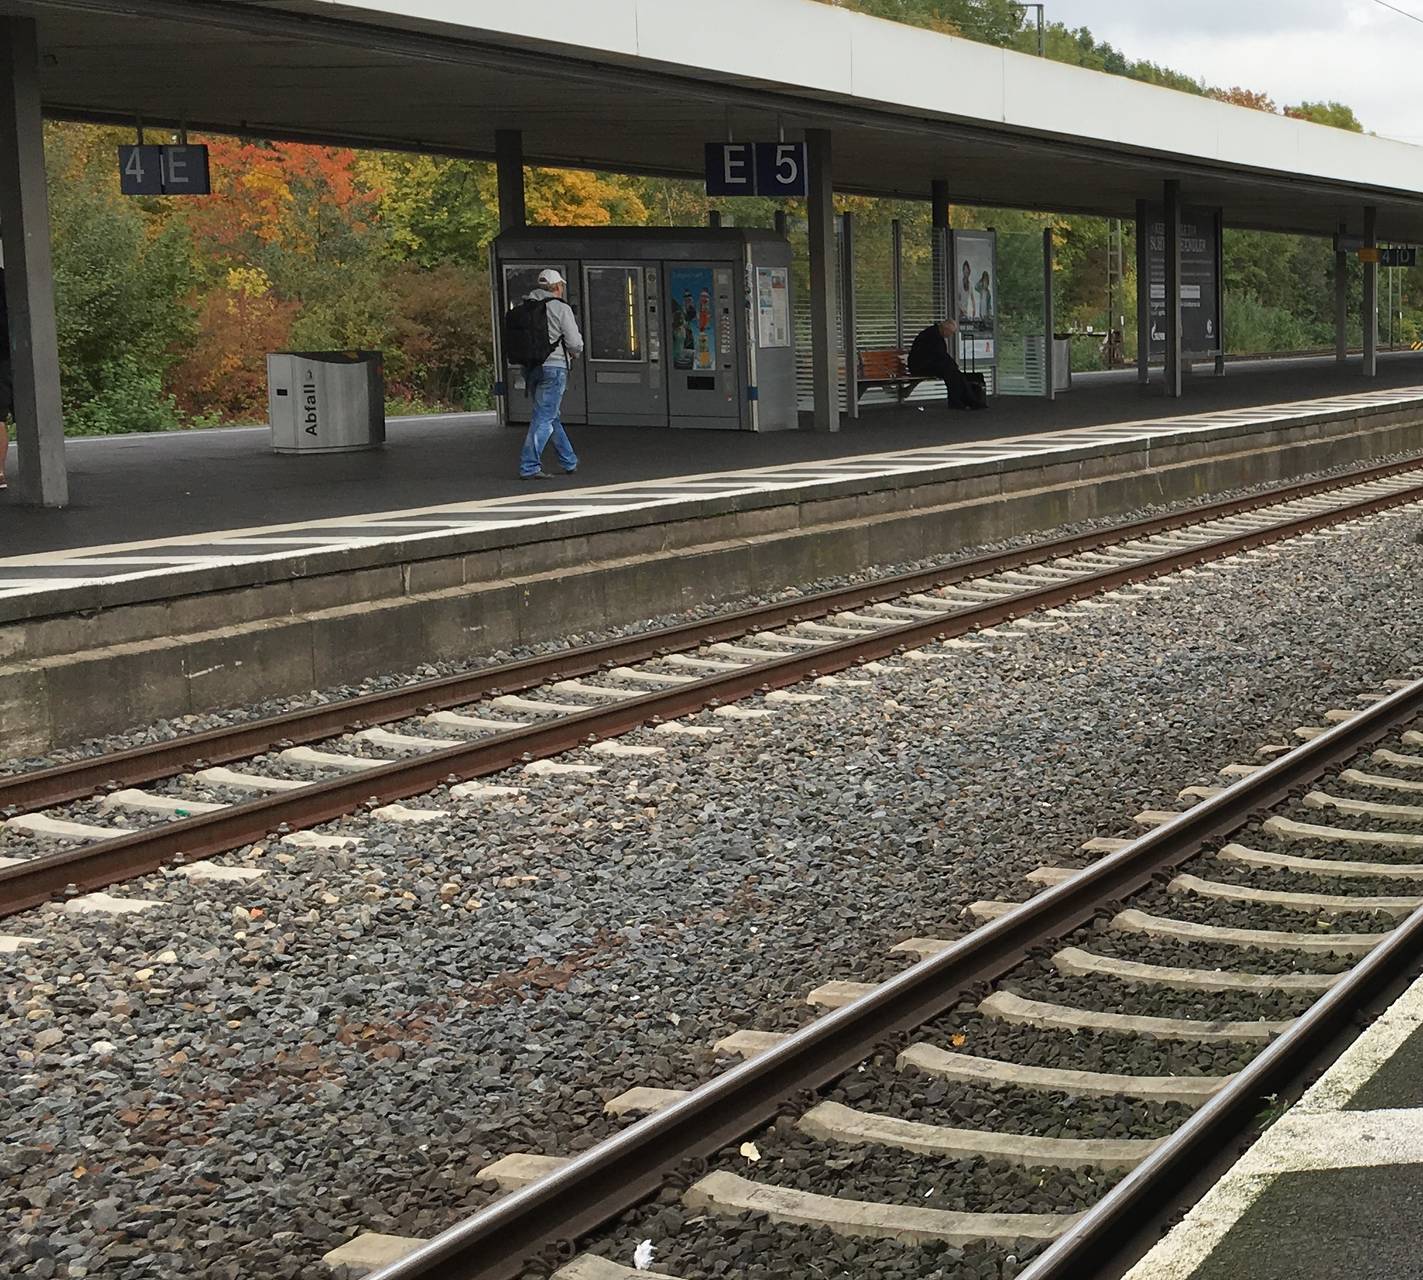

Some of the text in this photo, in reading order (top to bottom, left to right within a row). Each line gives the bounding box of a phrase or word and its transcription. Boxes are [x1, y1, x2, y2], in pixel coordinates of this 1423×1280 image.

[125, 147, 189, 184] 4 E
[723, 145, 798, 184] E 5
[1382, 250, 1410, 263] 4 D
[303, 384, 318, 436] Abfall
